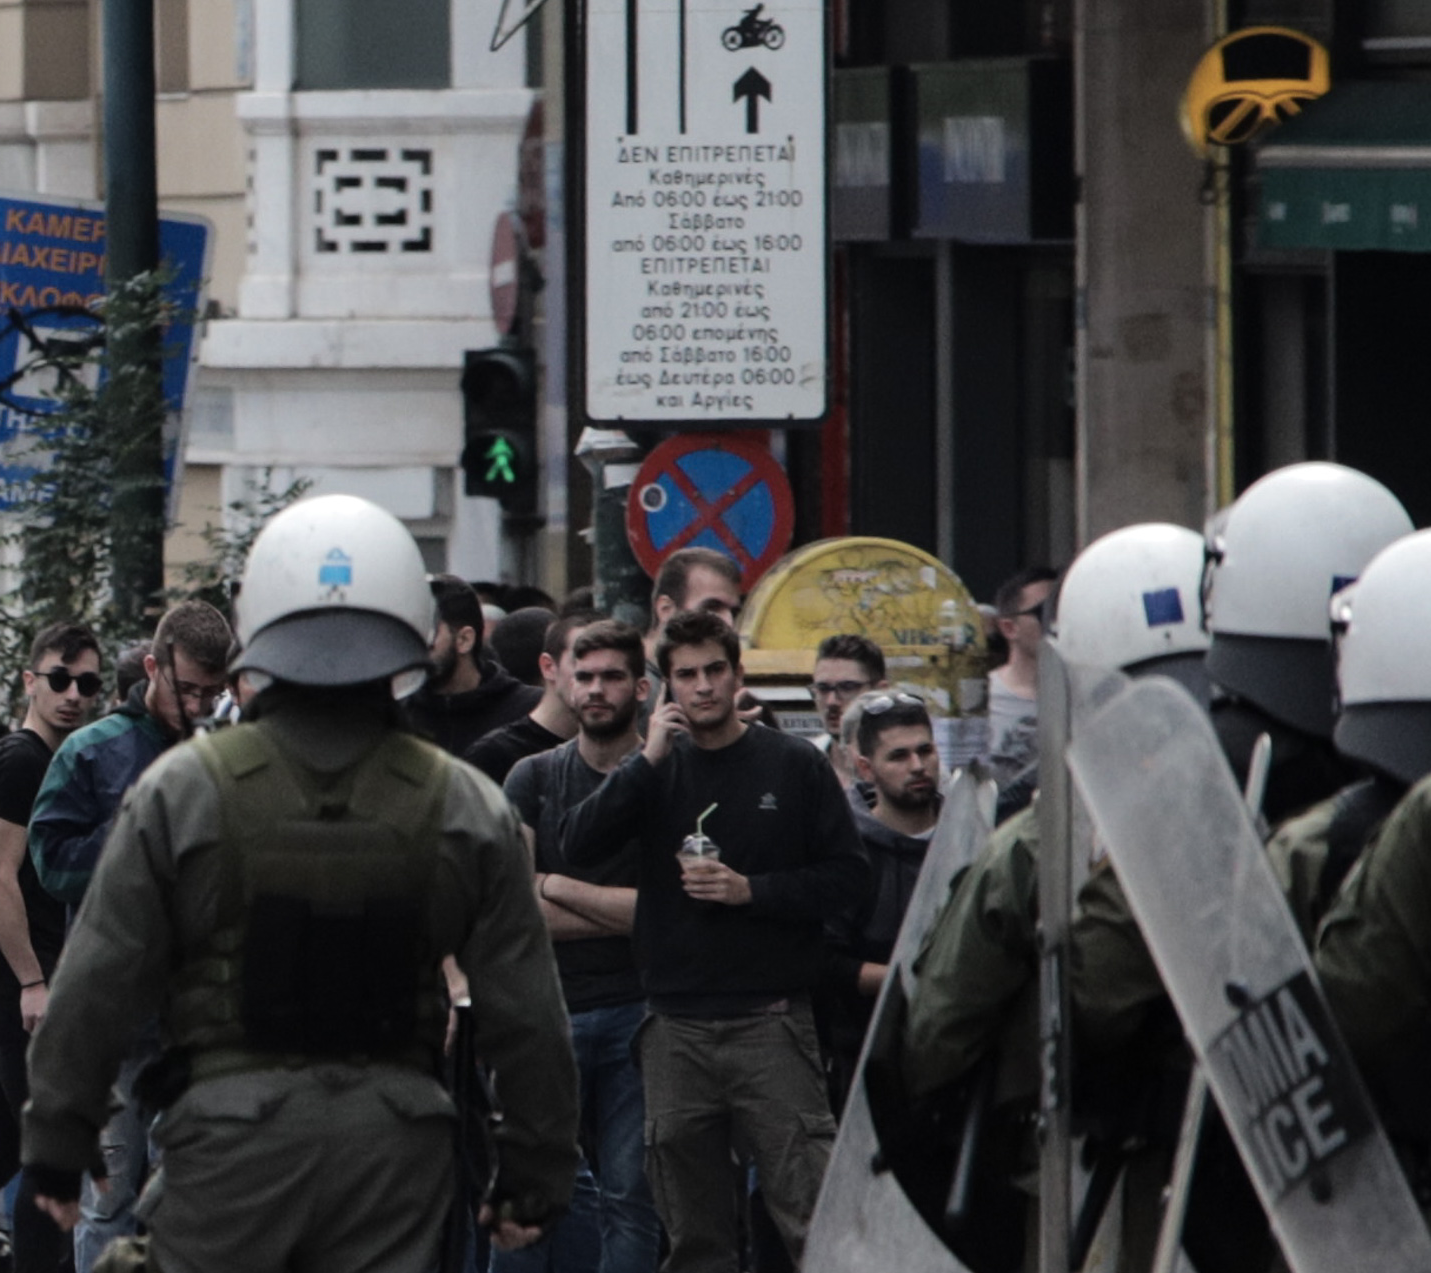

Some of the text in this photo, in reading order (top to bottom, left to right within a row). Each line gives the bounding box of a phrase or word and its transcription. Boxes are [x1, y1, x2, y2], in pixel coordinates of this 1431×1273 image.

[617, 145, 796, 163] ΔΕΝ ΕΠΙΤΡΕΠΕΤΑΙ
[649, 168, 766, 188] Καθημερινές
[611, 190, 645, 208] Από
[713, 189, 749, 211] έως
[668, 213, 745, 232] Σάββατο
[611, 235, 645, 252] από
[712, 235, 748, 255] έως
[640, 257, 770, 274] ΕΠΙΤΡΕΠΕΤΑΙ
[647, 279, 765, 299] Καθημερινές
[641, 302, 673, 318] από
[734, 302, 770, 321] έως
[692, 324, 778, 344] επομένης
[620, 346, 652, 363] από
[660, 346, 736, 365] Σάββατο
[616, 368, 652, 388] έως
[659, 368, 735, 388] Δευτέρα
[656, 391, 754, 411] και Αργίες
